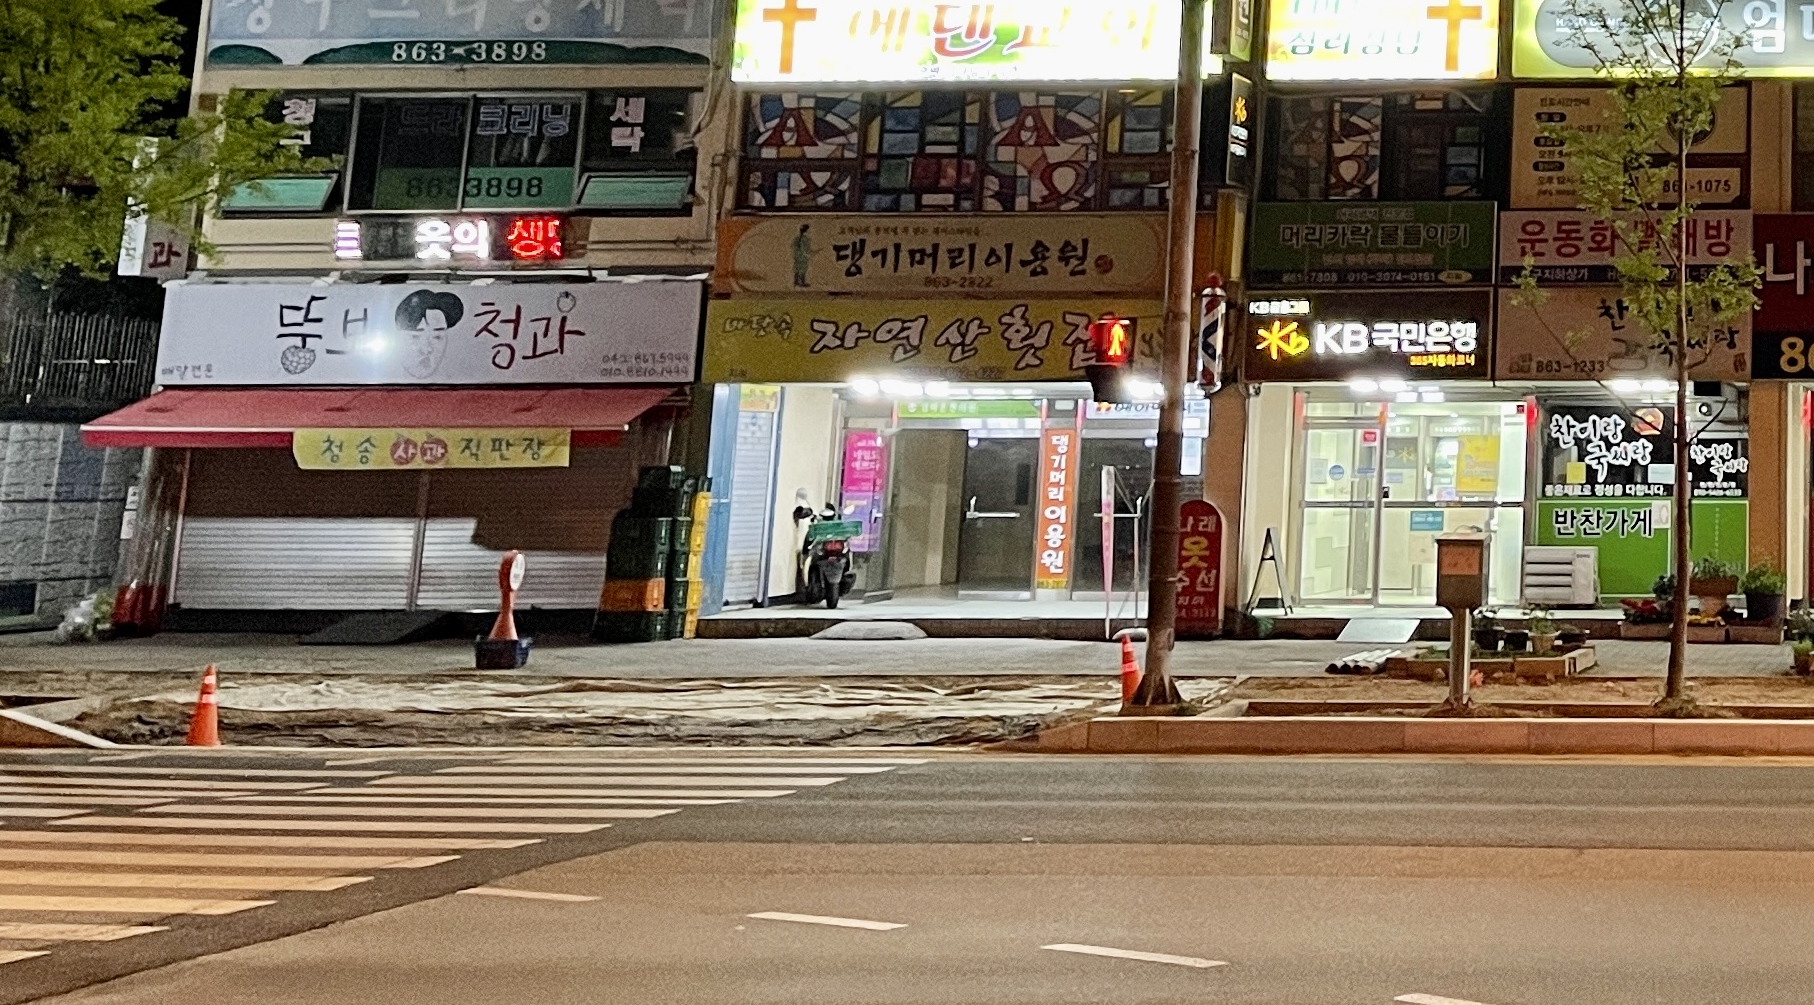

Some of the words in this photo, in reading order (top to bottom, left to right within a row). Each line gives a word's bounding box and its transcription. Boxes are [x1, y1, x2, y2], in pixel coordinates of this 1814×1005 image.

[476, 102, 572, 138] 크리닝
[610, 97, 646, 154] 세탁
[1279, 223, 1372, 248] 머리카락
[1377, 223, 1471, 248] 물들이기
[1517, 218, 1619, 259] 운동화
[832, 238, 1090, 278] 댕기머리이용원
[473, 300, 587, 370] 청과
[1314, 320, 1479, 355] KB국민은행
[1550, 413, 1627, 449] 찬이랑
[321, 435, 377, 464] 청송
[393, 438, 447, 464] 사과
[459, 436, 548, 463] 직판장
[1040, 434, 1070, 575] 댕기머리이용원
[1553, 507, 1655, 538] 반찬가게
[1181, 535, 1211, 569] 옷
